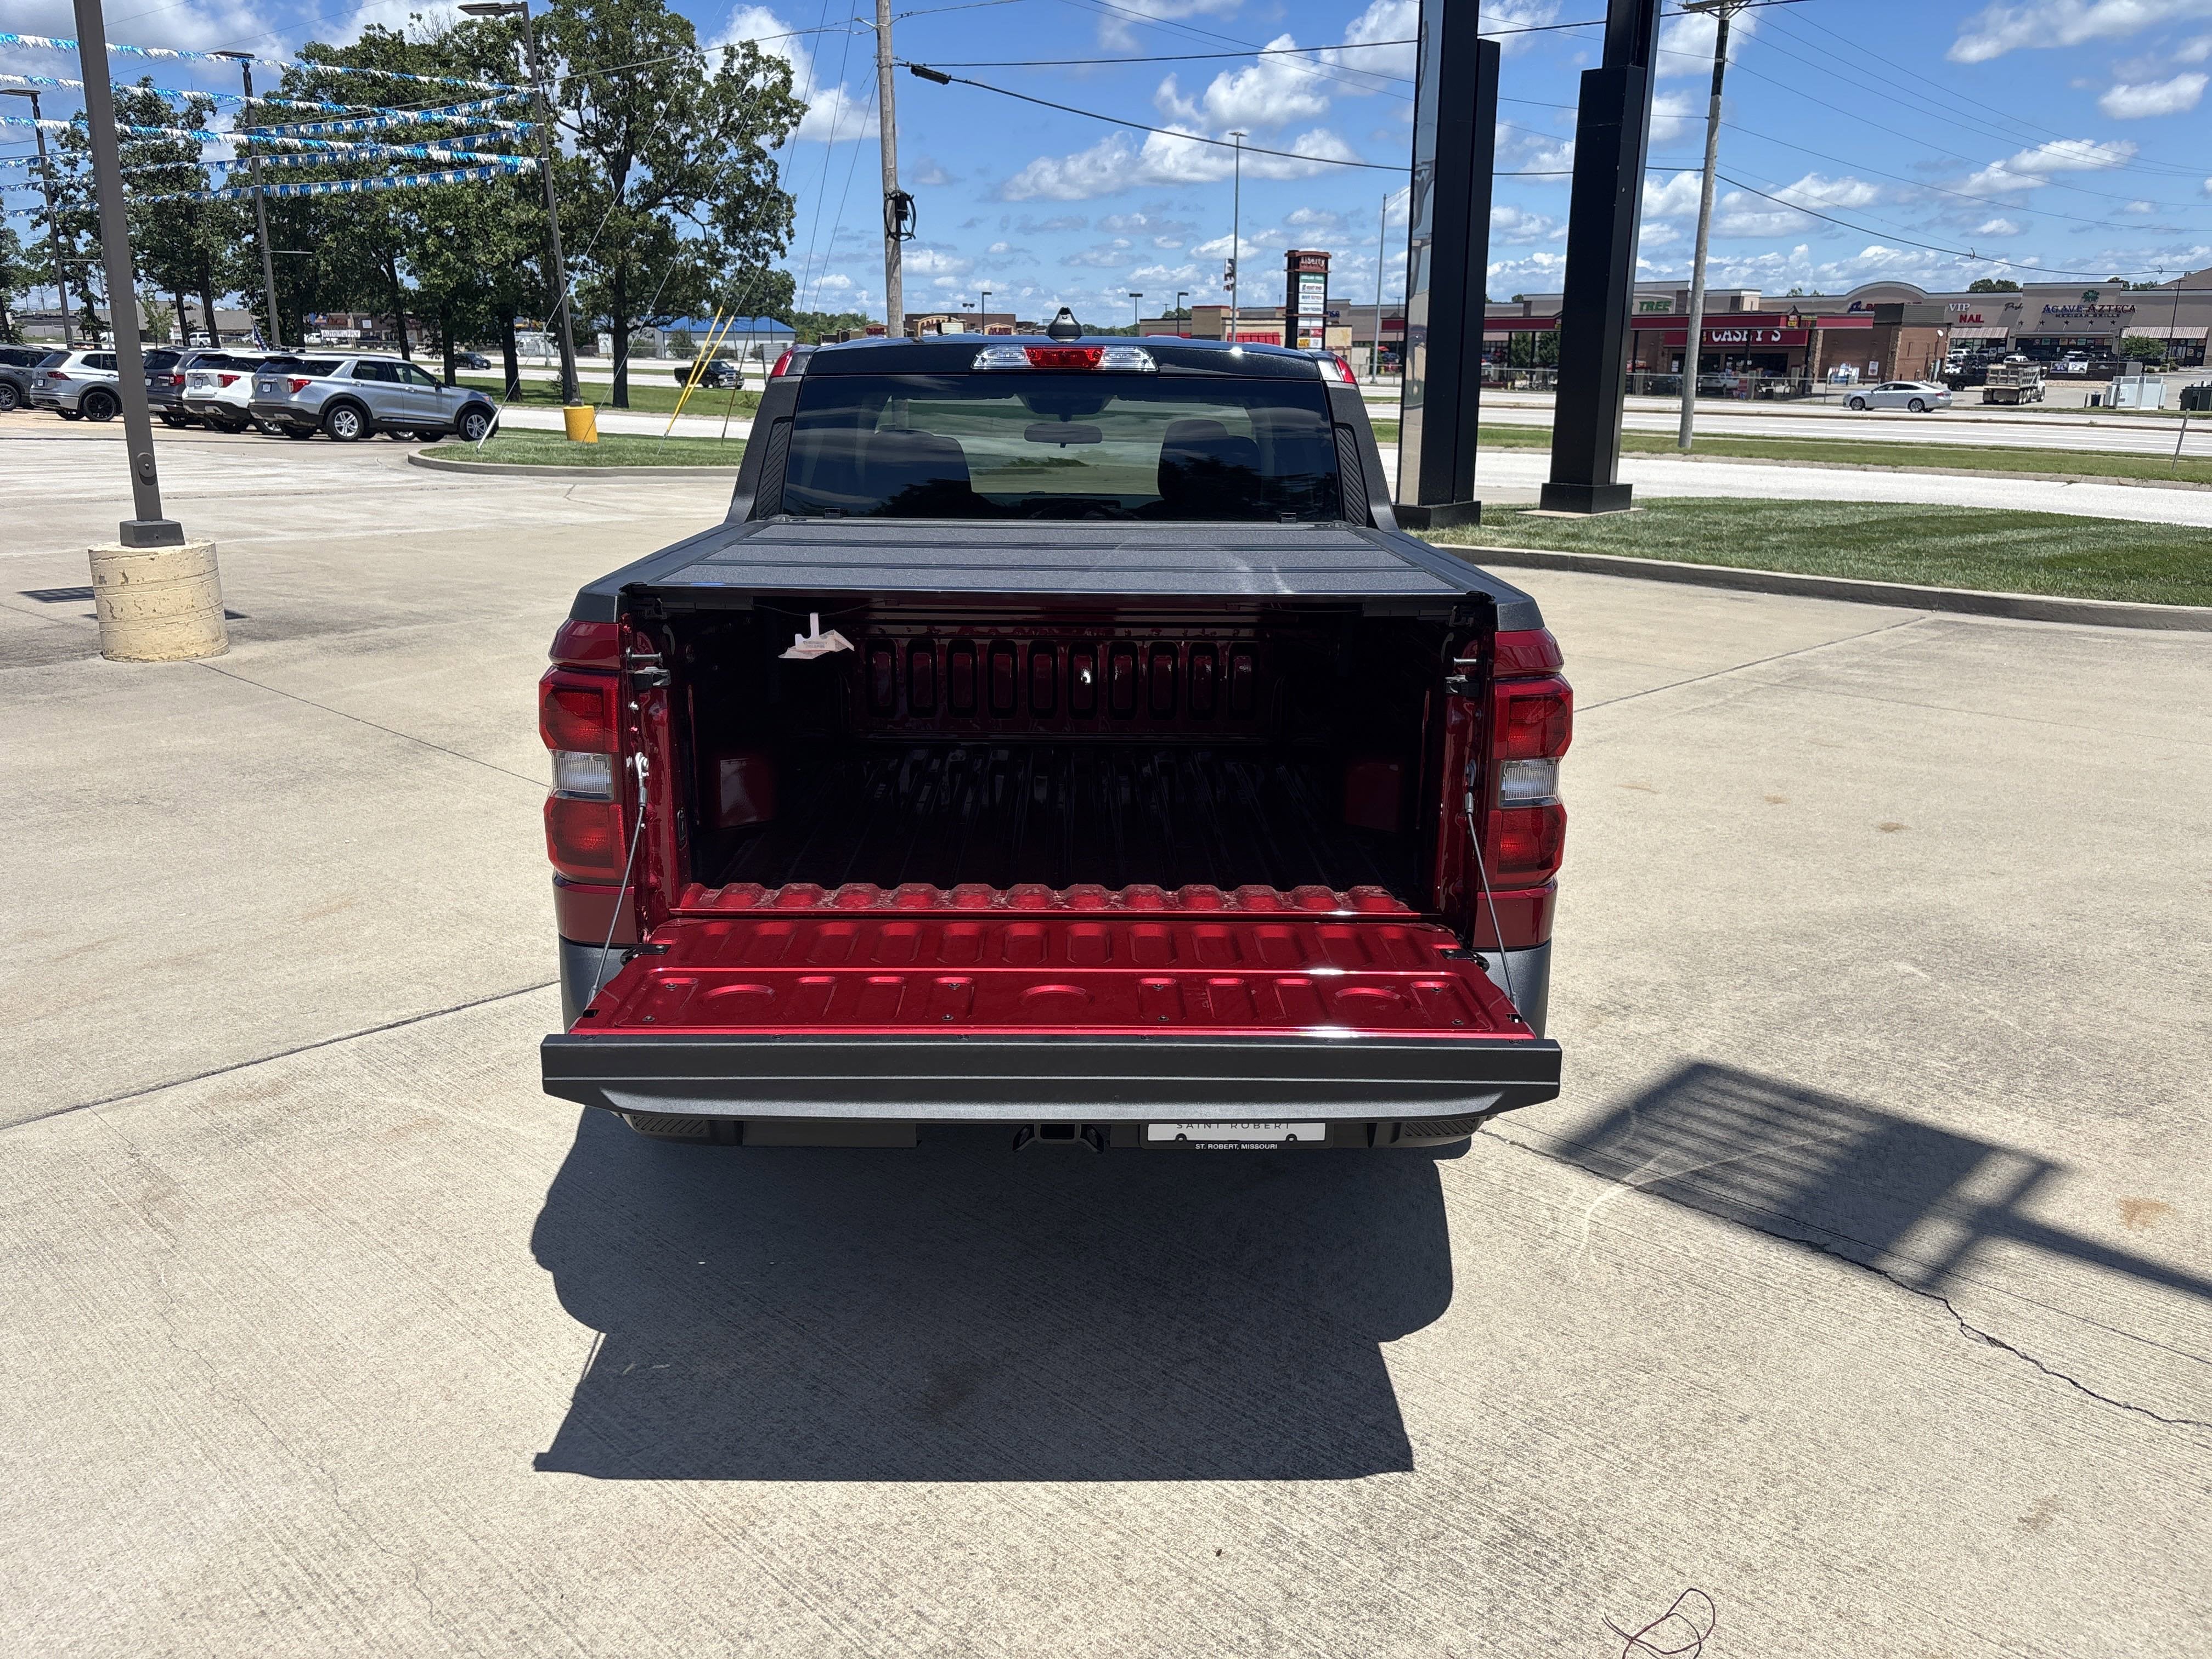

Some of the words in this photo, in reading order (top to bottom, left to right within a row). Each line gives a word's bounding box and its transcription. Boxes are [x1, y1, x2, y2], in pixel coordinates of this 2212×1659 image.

[1639, 301, 1672, 312] TREE
[1949, 303, 1971, 312] VIP
[2041, 304, 2083, 313] AGAVE
[2087, 303, 2137, 313] AZTECA
[1959, 314, 1984, 323] NAIL
[1712, 329, 1781, 342] CASYS
